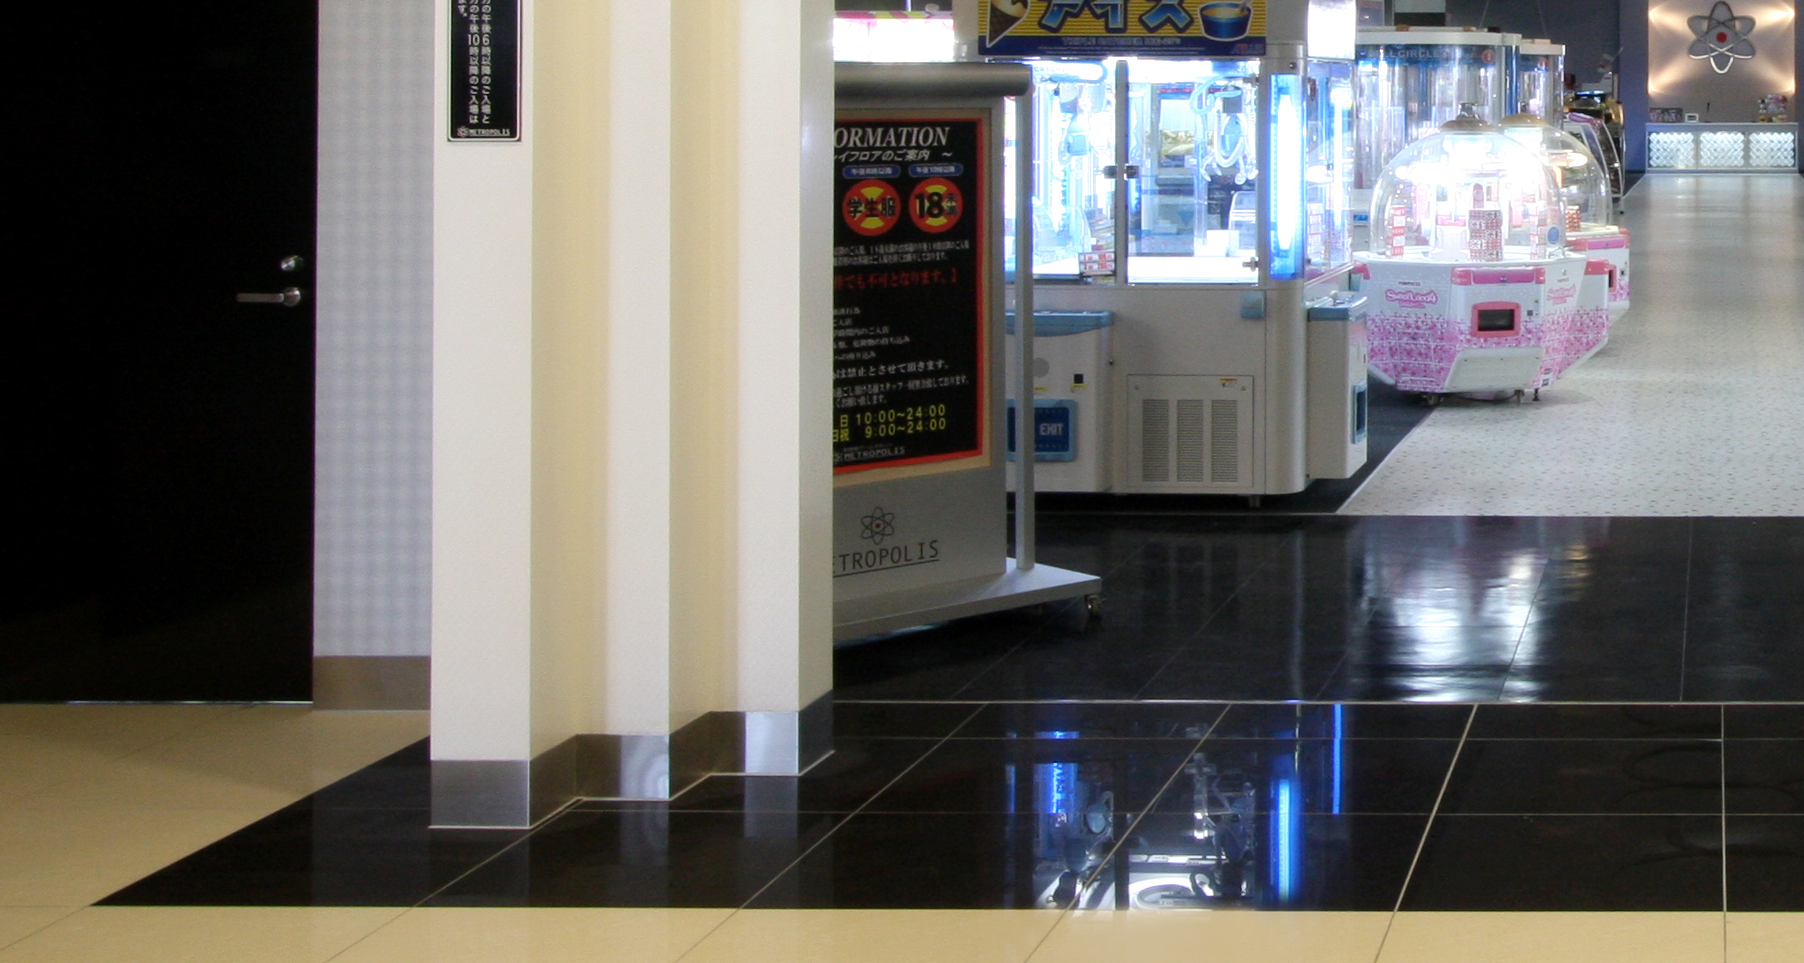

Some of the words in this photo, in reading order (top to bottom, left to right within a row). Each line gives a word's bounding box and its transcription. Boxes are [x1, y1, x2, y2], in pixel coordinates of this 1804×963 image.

[469, 128, 511, 136] METROPOLIS
[834, 149, 930, 163] イフロアのご案内
[847, 195, 896, 218] 学生服
[833, 359, 949, 379] は禁止とさせて頂きます。
[1040, 423, 1064, 436] EXIT
